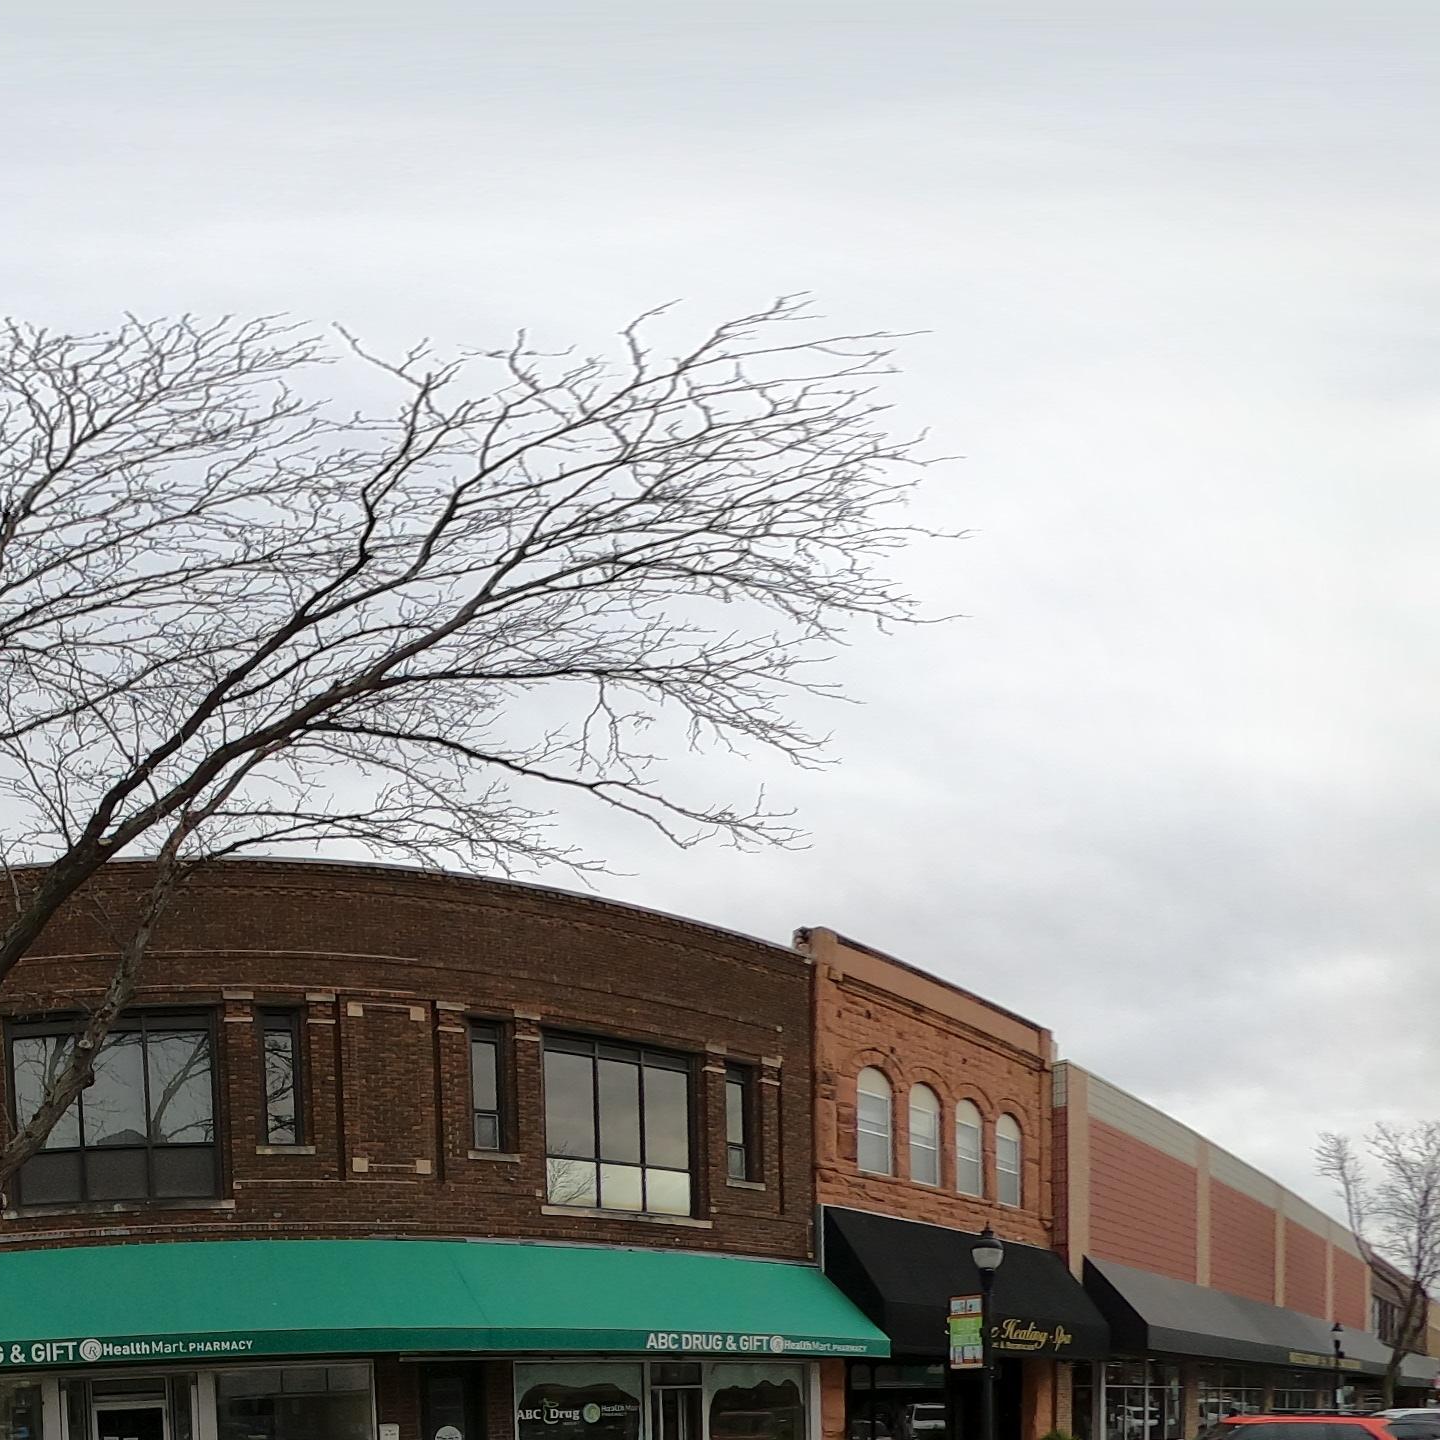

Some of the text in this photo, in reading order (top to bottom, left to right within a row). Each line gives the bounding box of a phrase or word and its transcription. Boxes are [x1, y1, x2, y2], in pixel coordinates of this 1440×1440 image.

[646, 1333, 679, 1350] ABC
[681, 1334, 722, 1351] DRUG
[726, 1335, 737, 1351] &
[740, 1335, 770, 1351] GIFT
[10, 1344, 26, 1364] &
[31, 1342, 77, 1362] GIFT
[189, 1340, 253, 1352] PHARMACY
[517, 1409, 542, 1420] ABC
[550, 1408, 580, 1420] Drug
